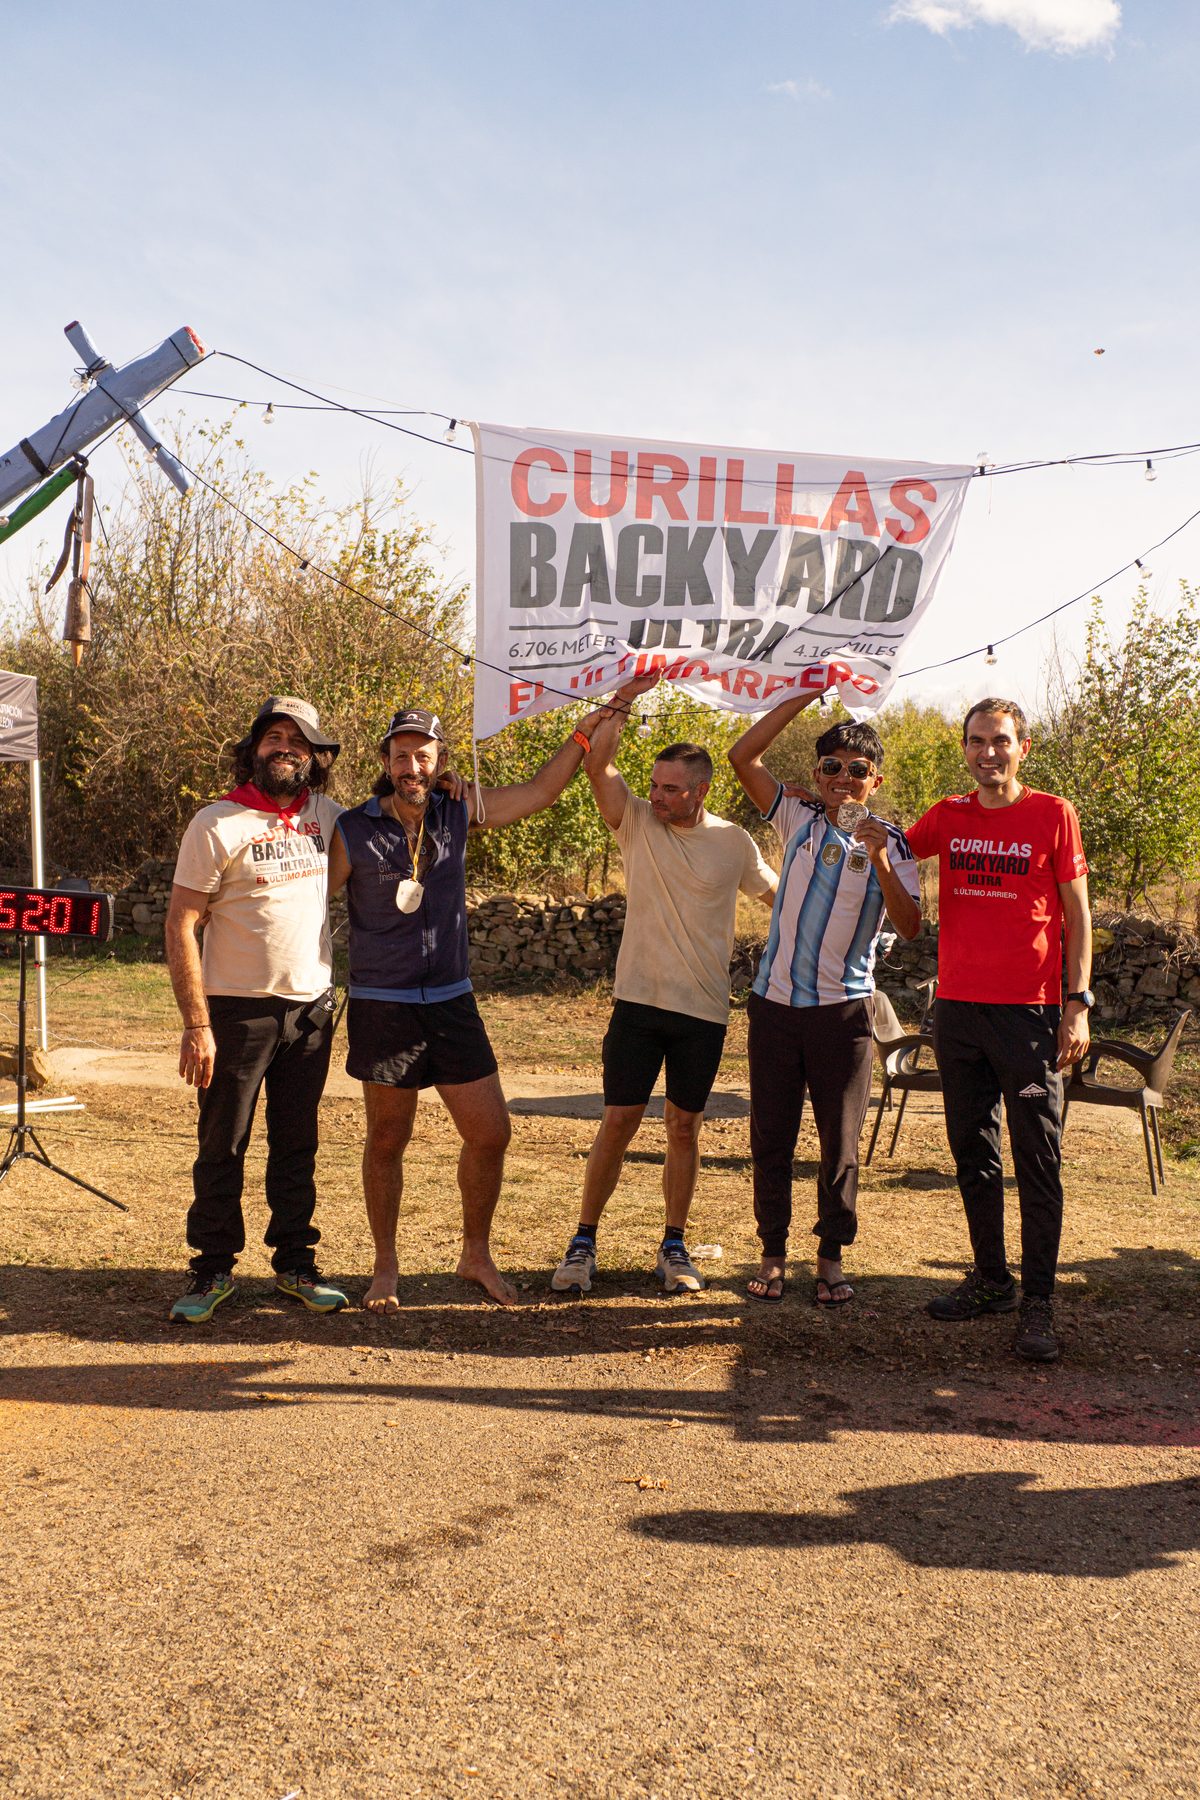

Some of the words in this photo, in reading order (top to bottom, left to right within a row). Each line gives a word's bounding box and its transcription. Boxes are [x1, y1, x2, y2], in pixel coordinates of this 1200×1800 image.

[510, 447, 938, 544] CURILLAS
[509, 521, 923, 623] BACKYARD
[508, 641, 558, 658] 6.706
[627, 618, 790, 664] ULTRA
[843, 641, 899, 657] MILES
[251, 821, 321, 844] CURAS
[950, 838, 1033, 857] CURILLAS
[280, 858, 313, 873] ULTRA
[950, 853, 1030, 876] BACKYARD
[256, 876, 269, 885] EL
[301, 866, 327, 879] ARRIE
[967, 874, 1002, 887] ULTRA
[986, 890, 1018, 900] ARRIERO
